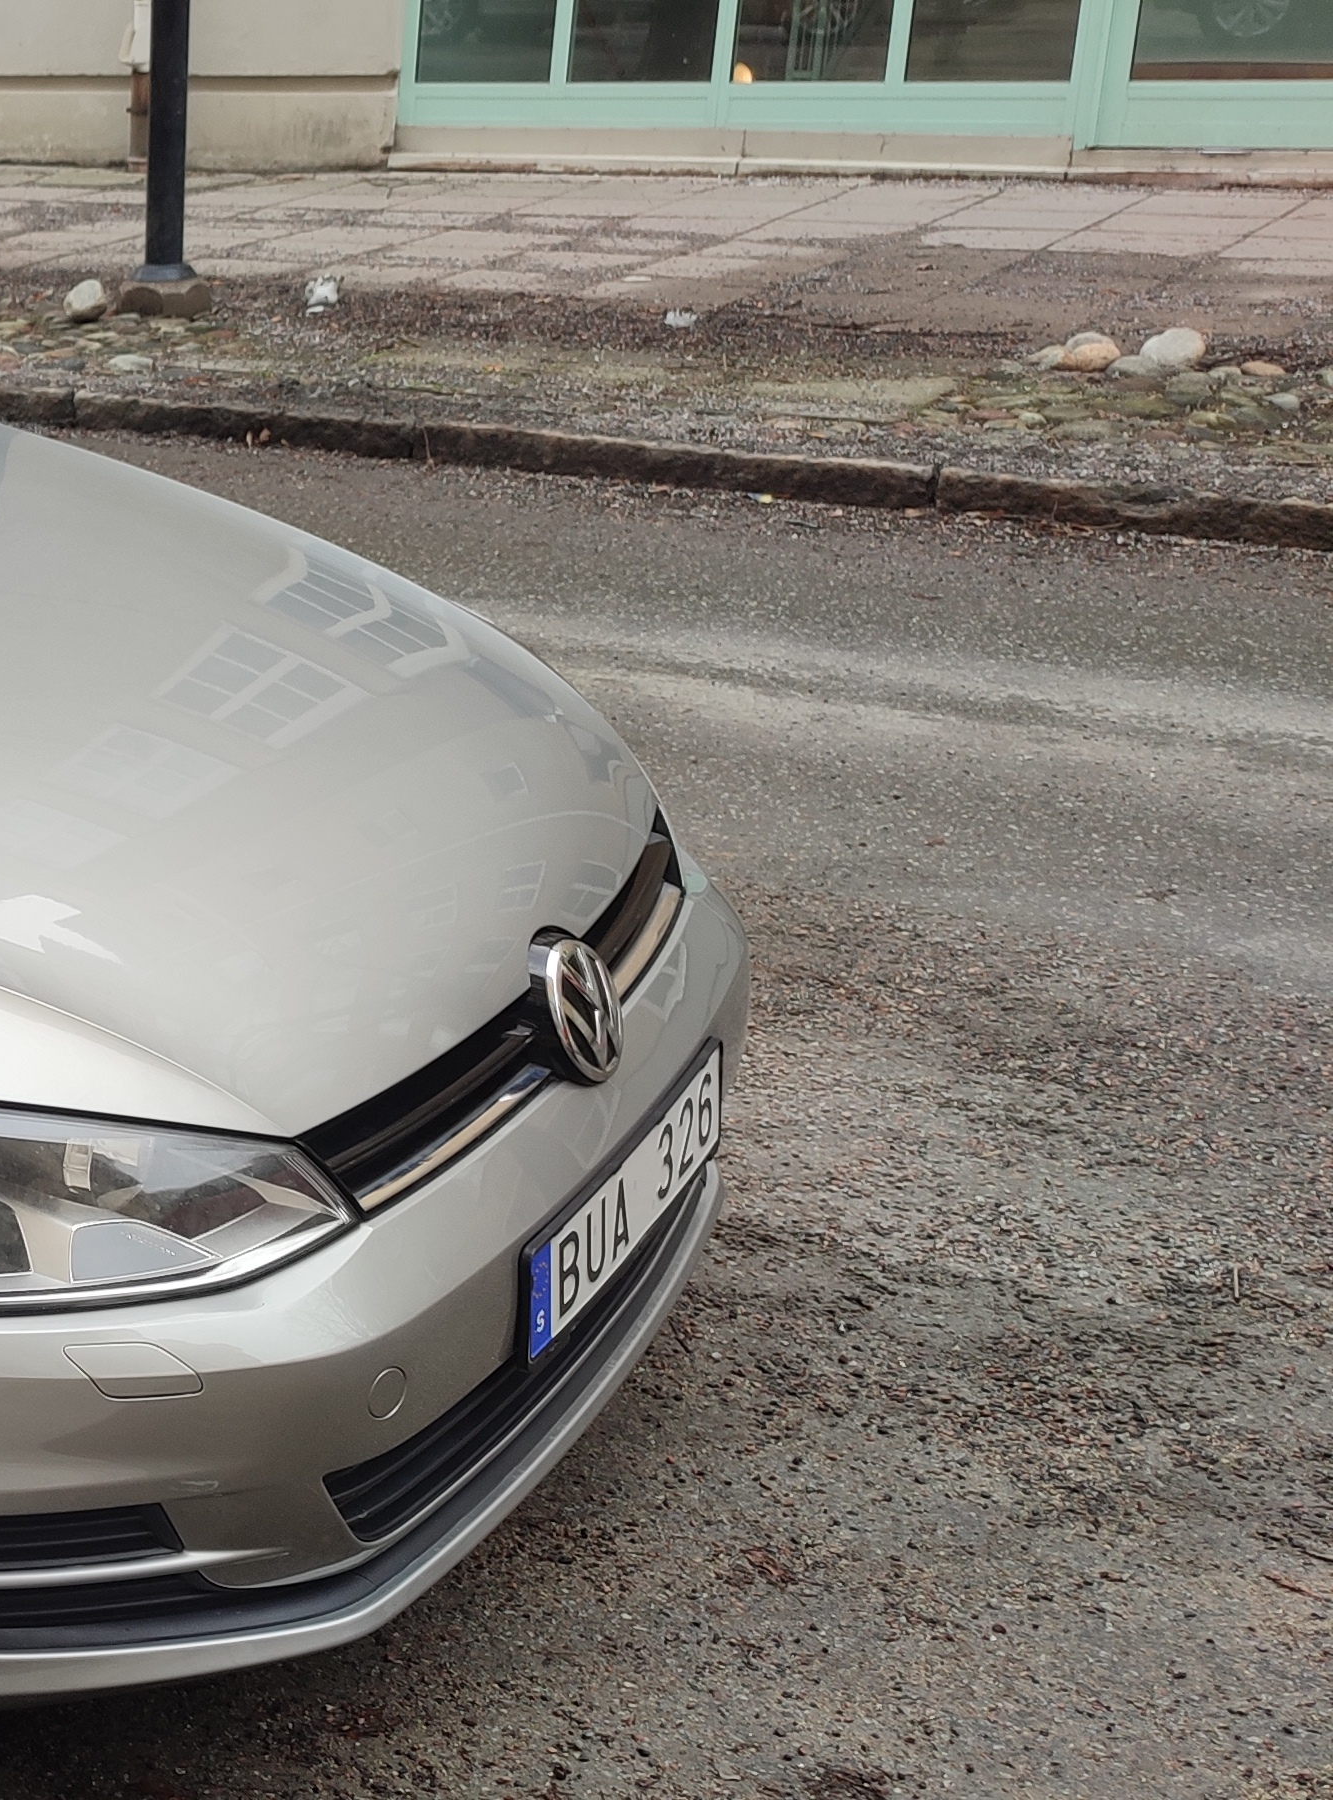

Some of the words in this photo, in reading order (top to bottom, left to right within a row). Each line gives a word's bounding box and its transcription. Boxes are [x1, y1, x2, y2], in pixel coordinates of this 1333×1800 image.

[558, 1177, 630, 1320] BUA
[657, 1071, 713, 1200] 326
[536, 1308, 545, 1333] S
